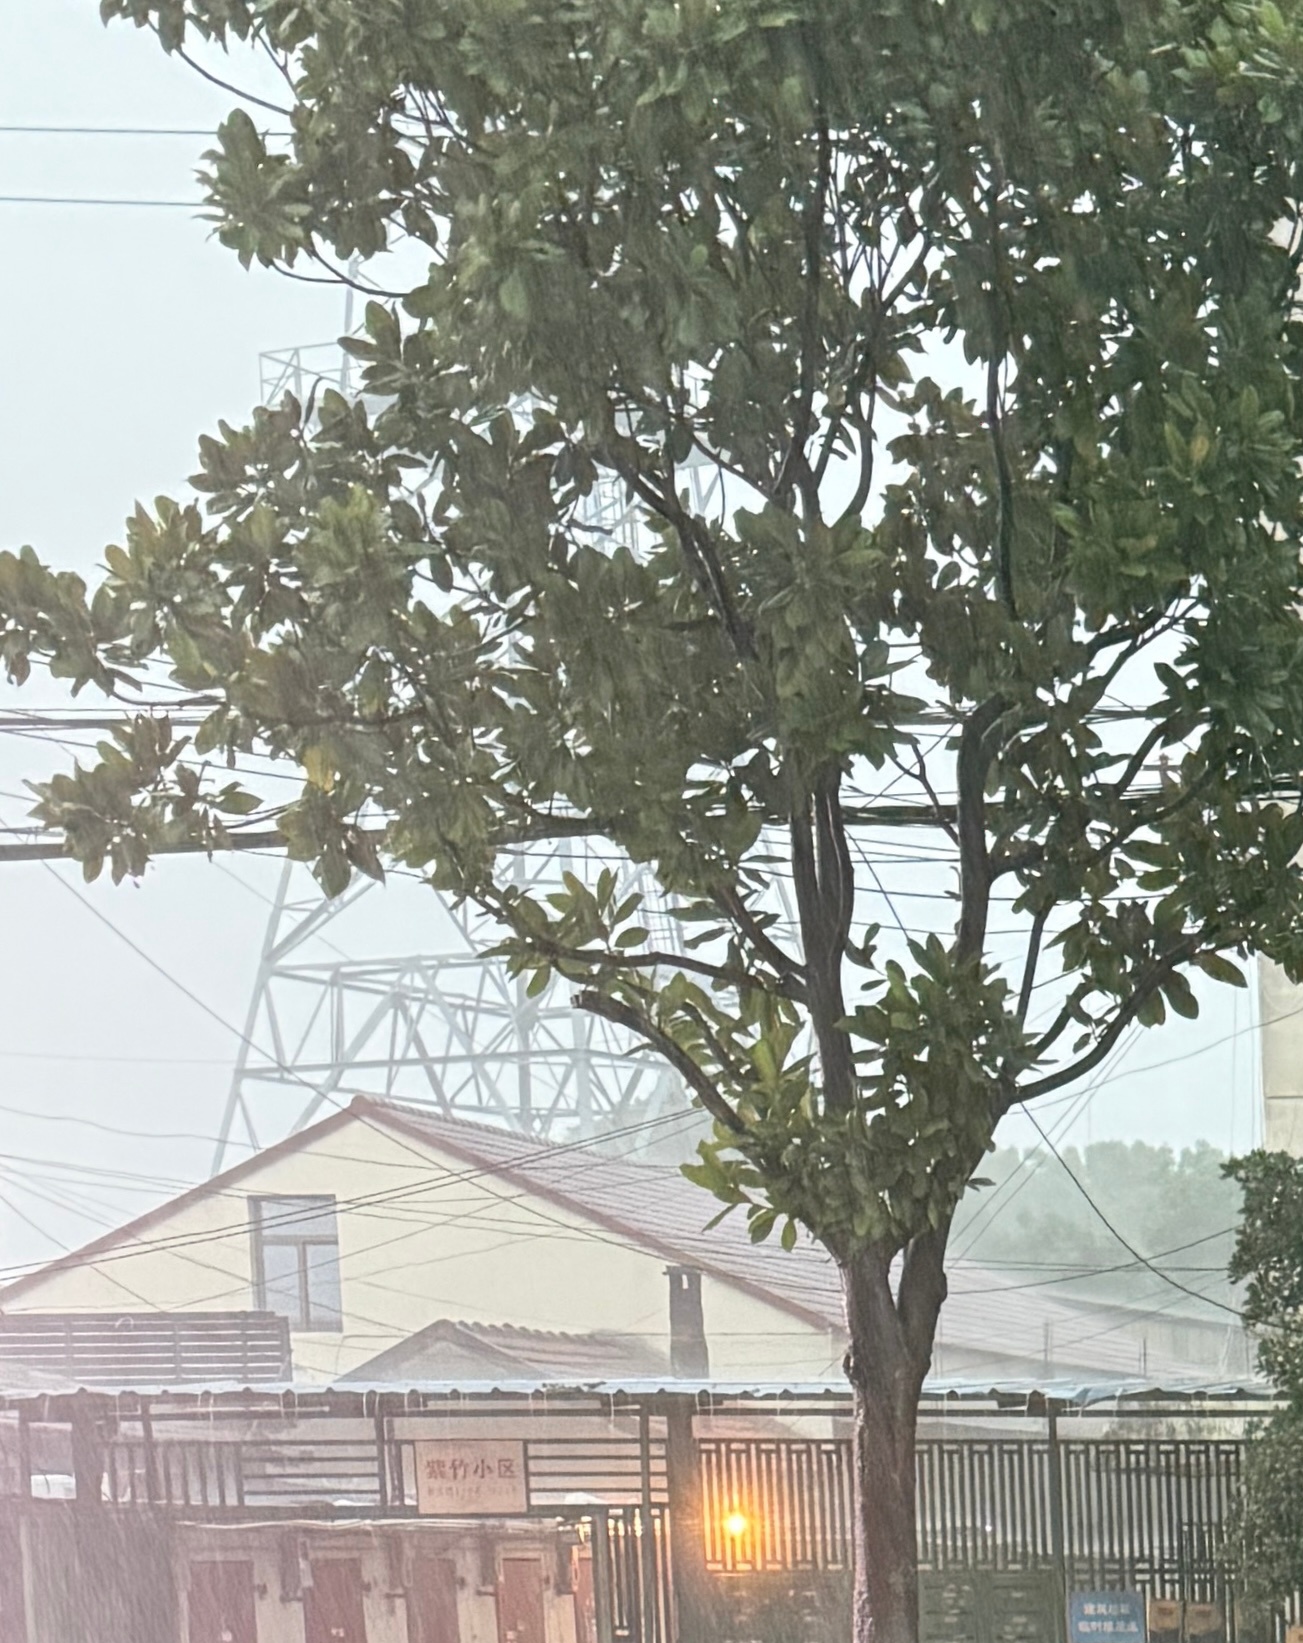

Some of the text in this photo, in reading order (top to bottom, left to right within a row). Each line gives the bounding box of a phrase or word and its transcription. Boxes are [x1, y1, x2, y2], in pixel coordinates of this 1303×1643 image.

[425, 1458, 517, 1480] 紫竹小区
[1083, 1603, 1130, 1615] 建筑垃圾
